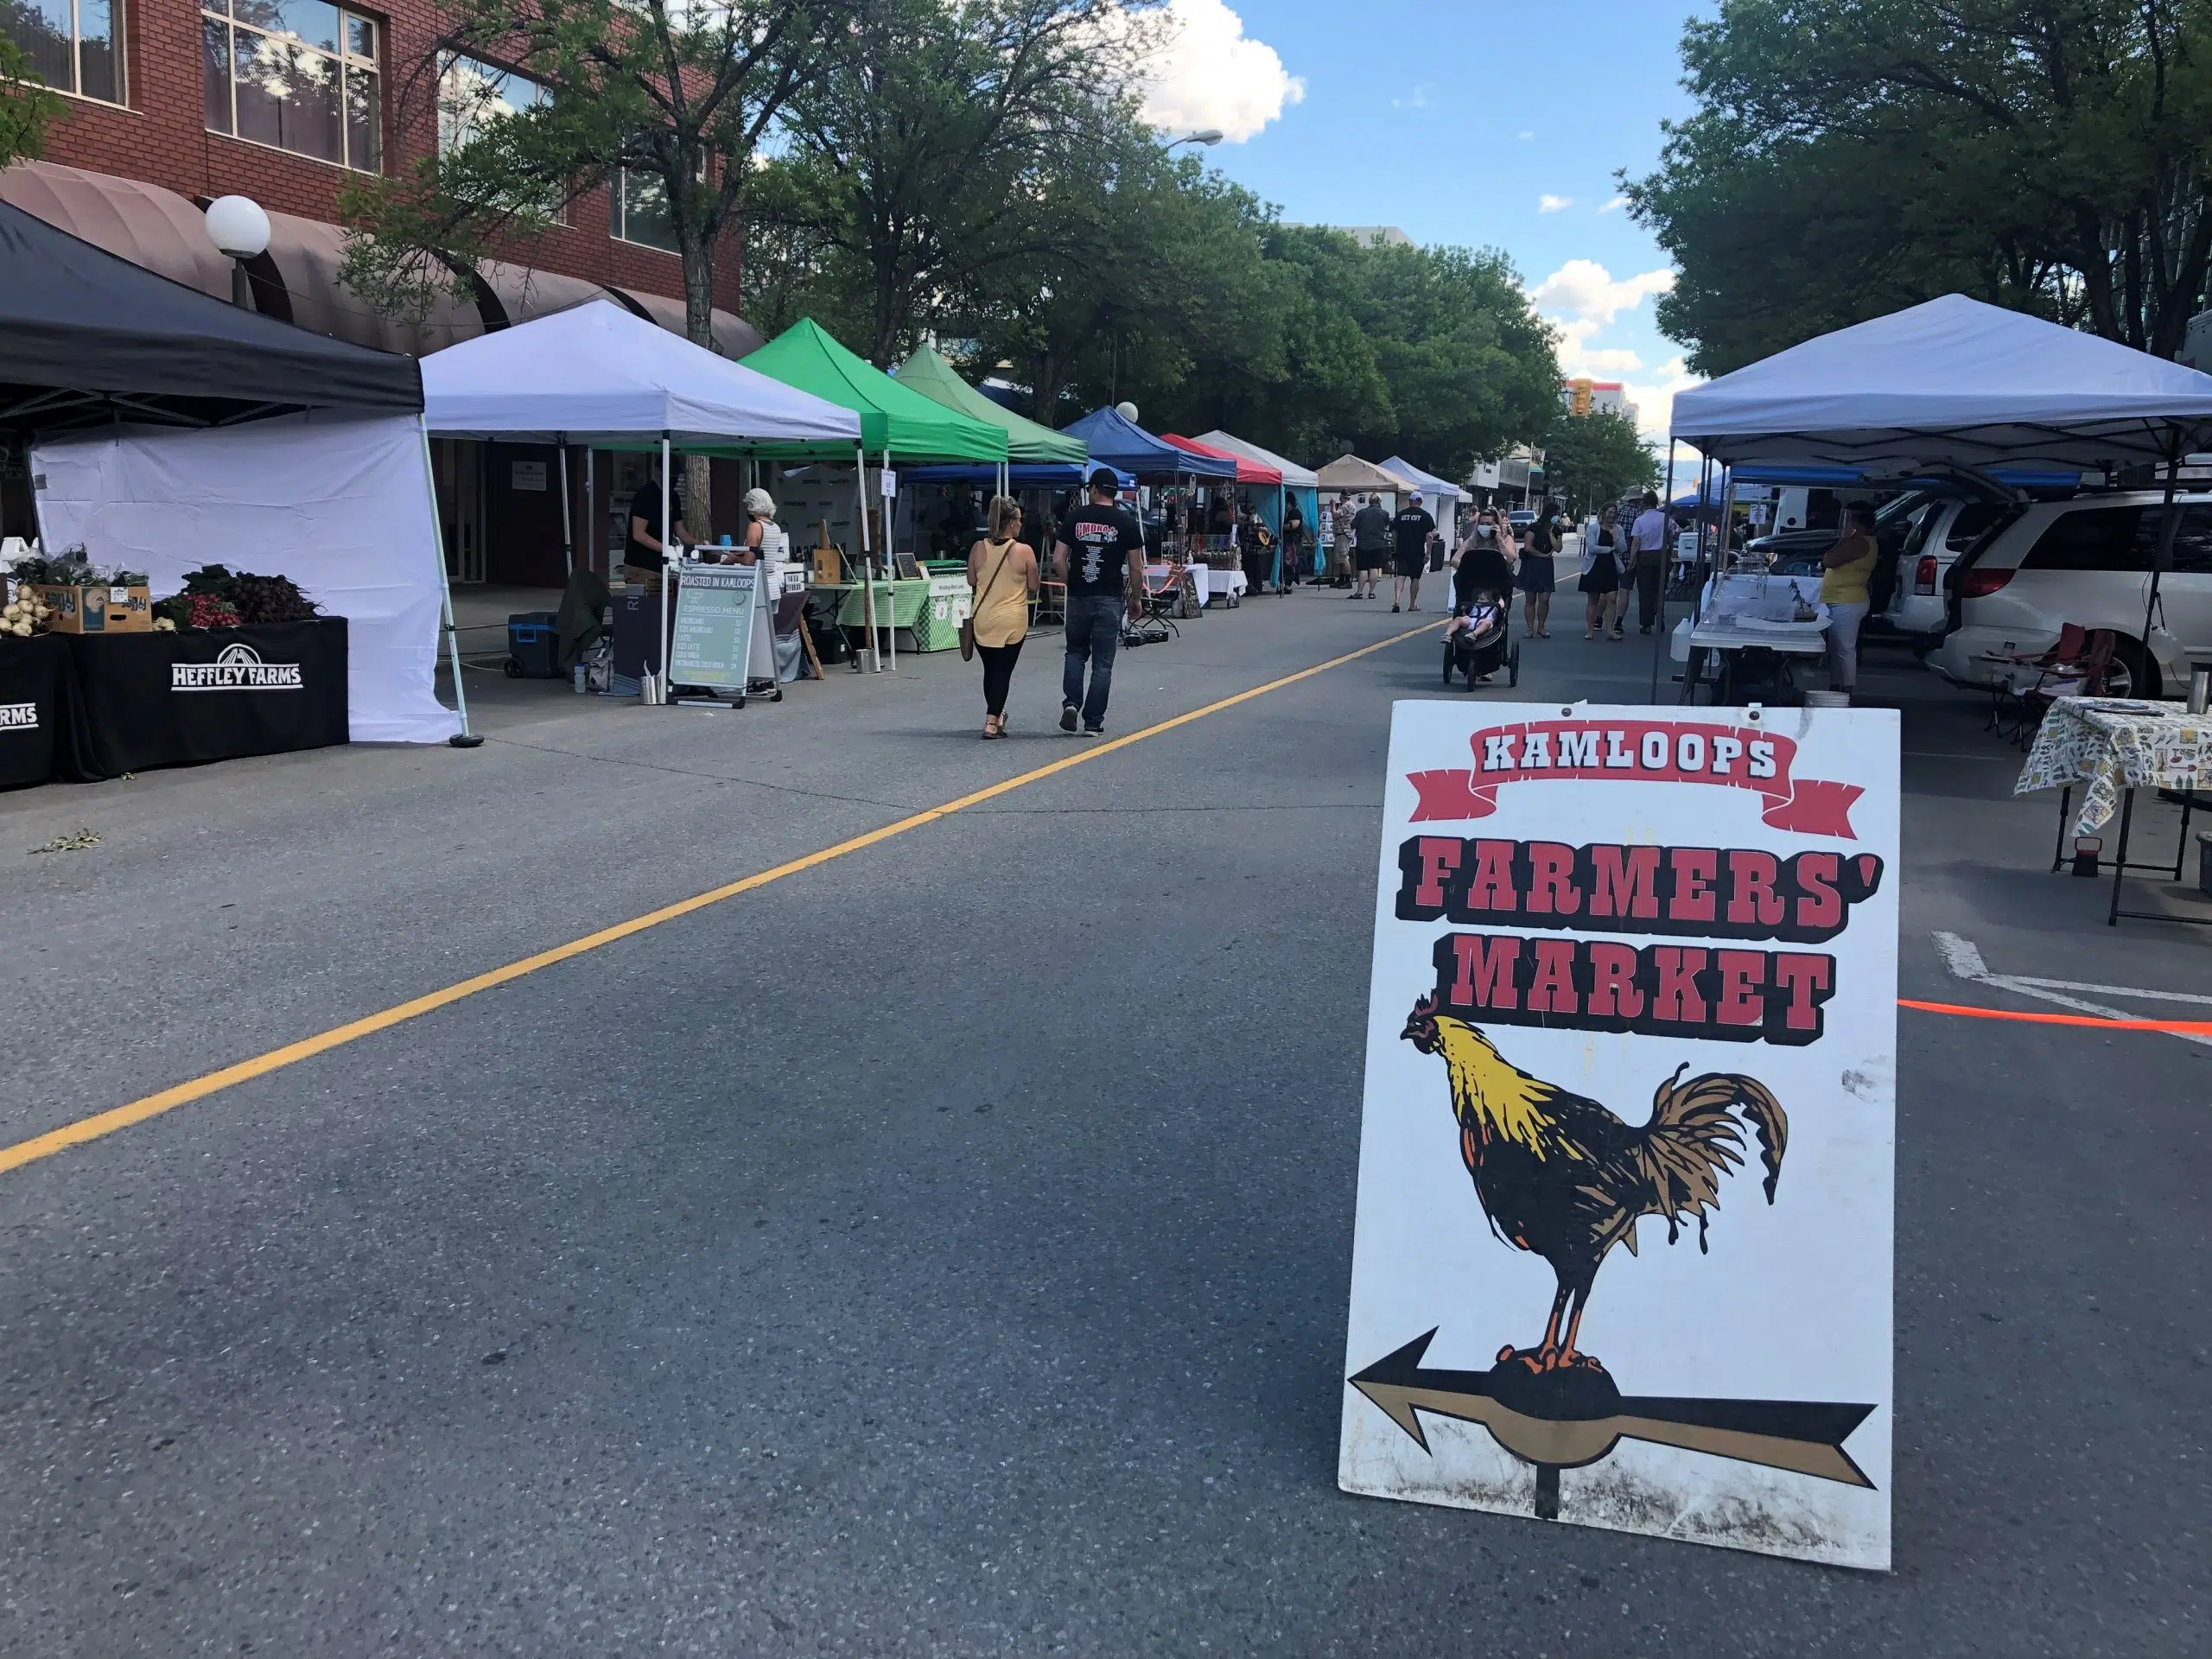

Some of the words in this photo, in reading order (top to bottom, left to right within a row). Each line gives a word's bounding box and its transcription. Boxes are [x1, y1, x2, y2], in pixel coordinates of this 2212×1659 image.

[681, 575, 710, 588] ROASTED
[713, 576, 720, 588] IN
[721, 577, 755, 588] KAMLOOPS
[683, 605, 721, 613] ESPRESSO
[722, 607, 744, 615] MENU
[173, 667, 246, 685] HEFFLEY
[248, 667, 302, 684] FARMS
[0, 707, 37, 726] RMS
[1483, 730, 1777, 778] KAMLOOPS
[1400, 836, 1882, 938] FARMERS'
[1440, 933, 1833, 1039] MARKET
